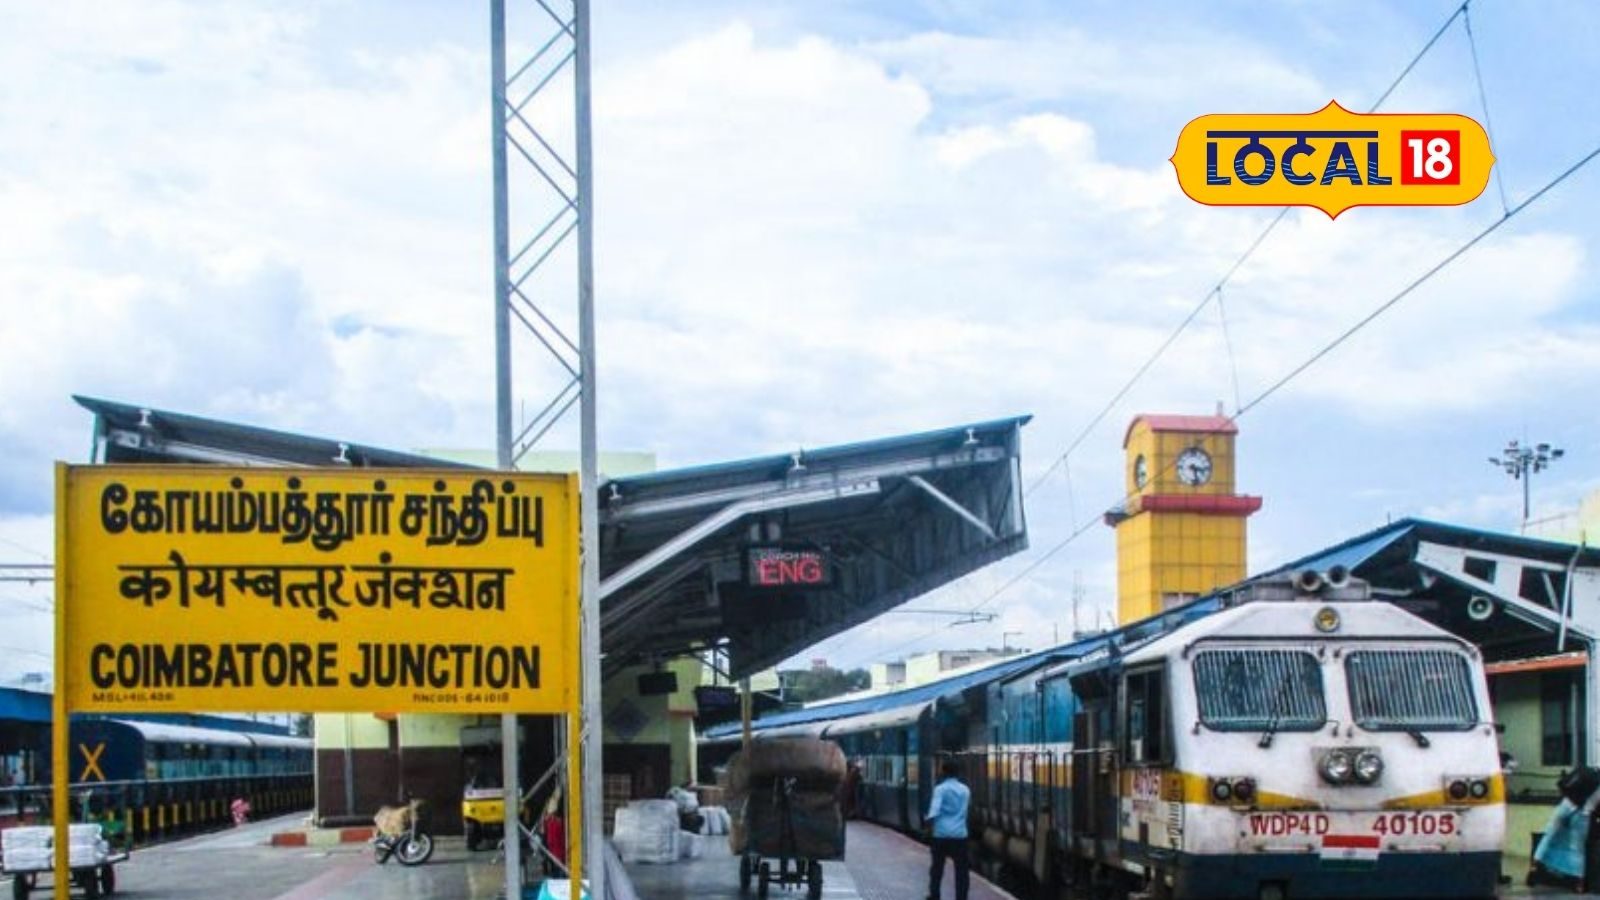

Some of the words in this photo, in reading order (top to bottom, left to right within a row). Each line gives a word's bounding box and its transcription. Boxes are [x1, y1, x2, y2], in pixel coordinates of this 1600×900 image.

[100, 477, 395, 550] கோயம்பத்தூர்
[399, 479, 543, 547] சந்திப்பு
[119, 552, 349, 621] कोयम्बत्तूर
[352, 552, 514, 611] जंक्शन
[759, 559, 822, 584] ENG
[90, 642, 339, 690] COIMBATORE
[349, 643, 540, 690] JUNCTION
[1372, 814, 1455, 836] 40105
